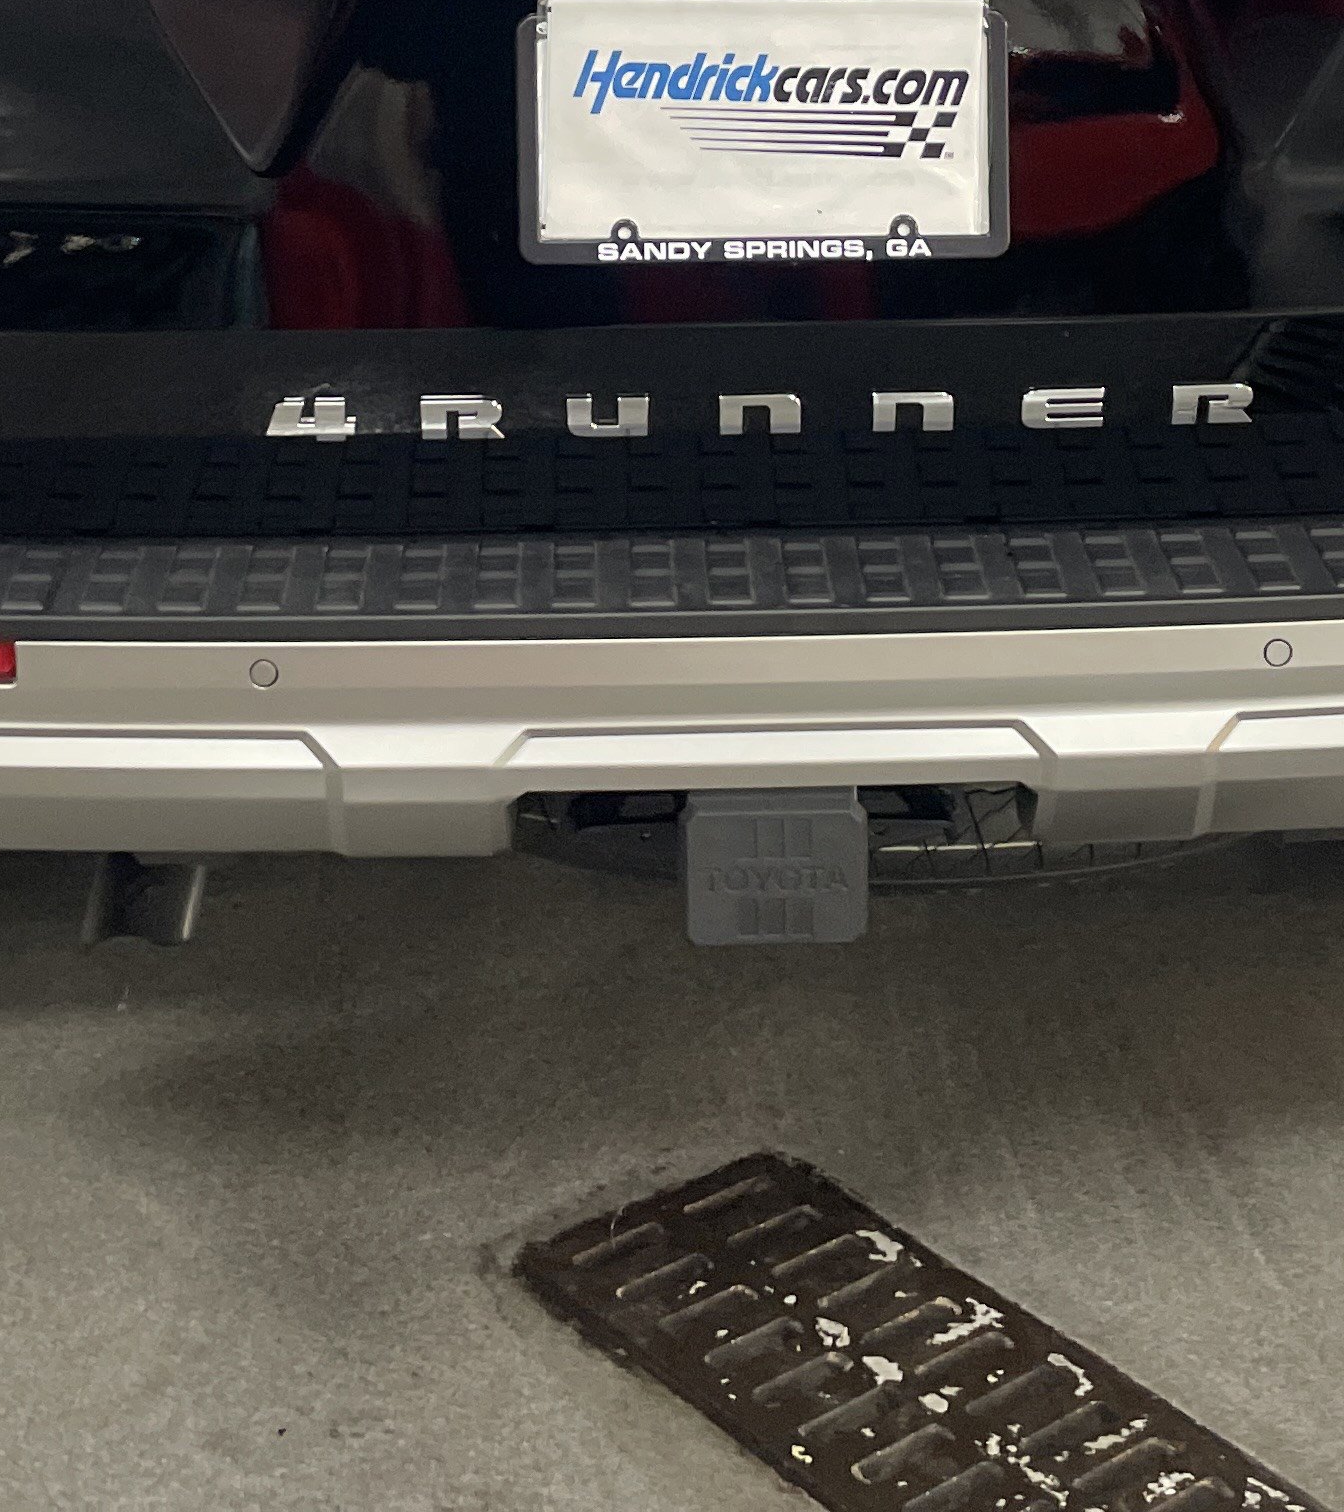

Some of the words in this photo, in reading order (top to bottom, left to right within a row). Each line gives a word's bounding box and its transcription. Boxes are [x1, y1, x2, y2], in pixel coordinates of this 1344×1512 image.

[573, 50, 969, 114] Hendrickcars.com
[598, 241, 712, 261] SANDY
[723, 239, 873, 261] SPRINGS,
[886, 238, 932, 258] GA
